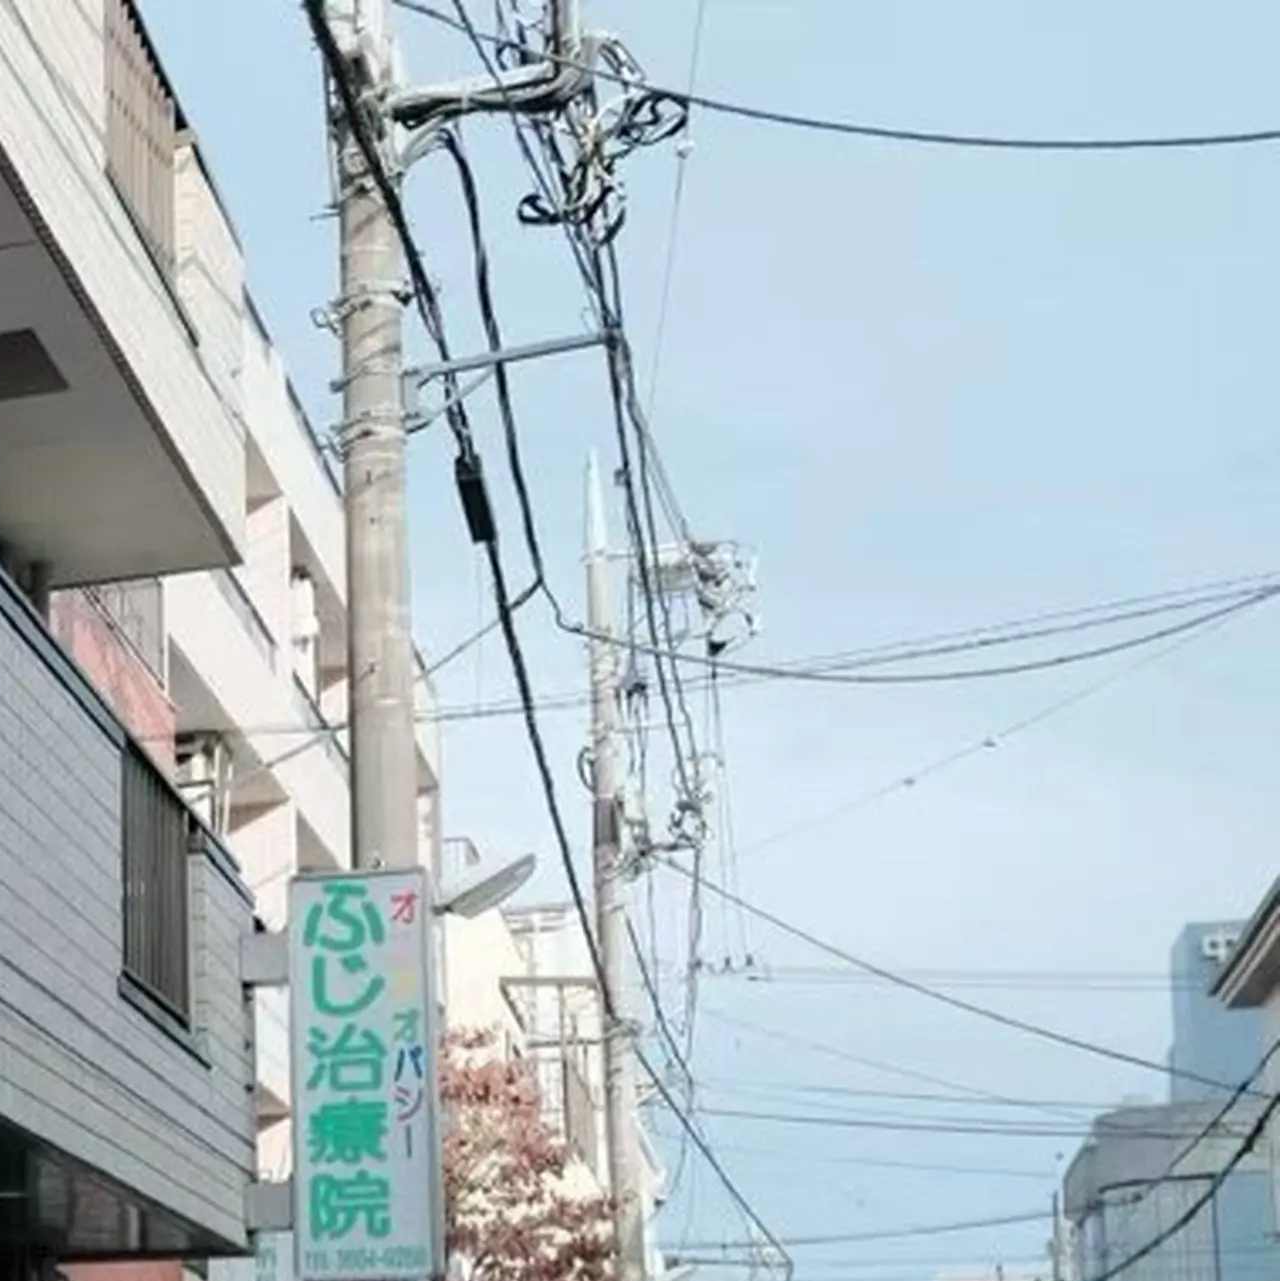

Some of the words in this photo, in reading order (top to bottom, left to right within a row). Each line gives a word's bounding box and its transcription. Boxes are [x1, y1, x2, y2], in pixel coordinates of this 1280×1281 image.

[302, 882, 392, 1242] ふじ治療院
[390, 888, 424, 1160] オオパシー
